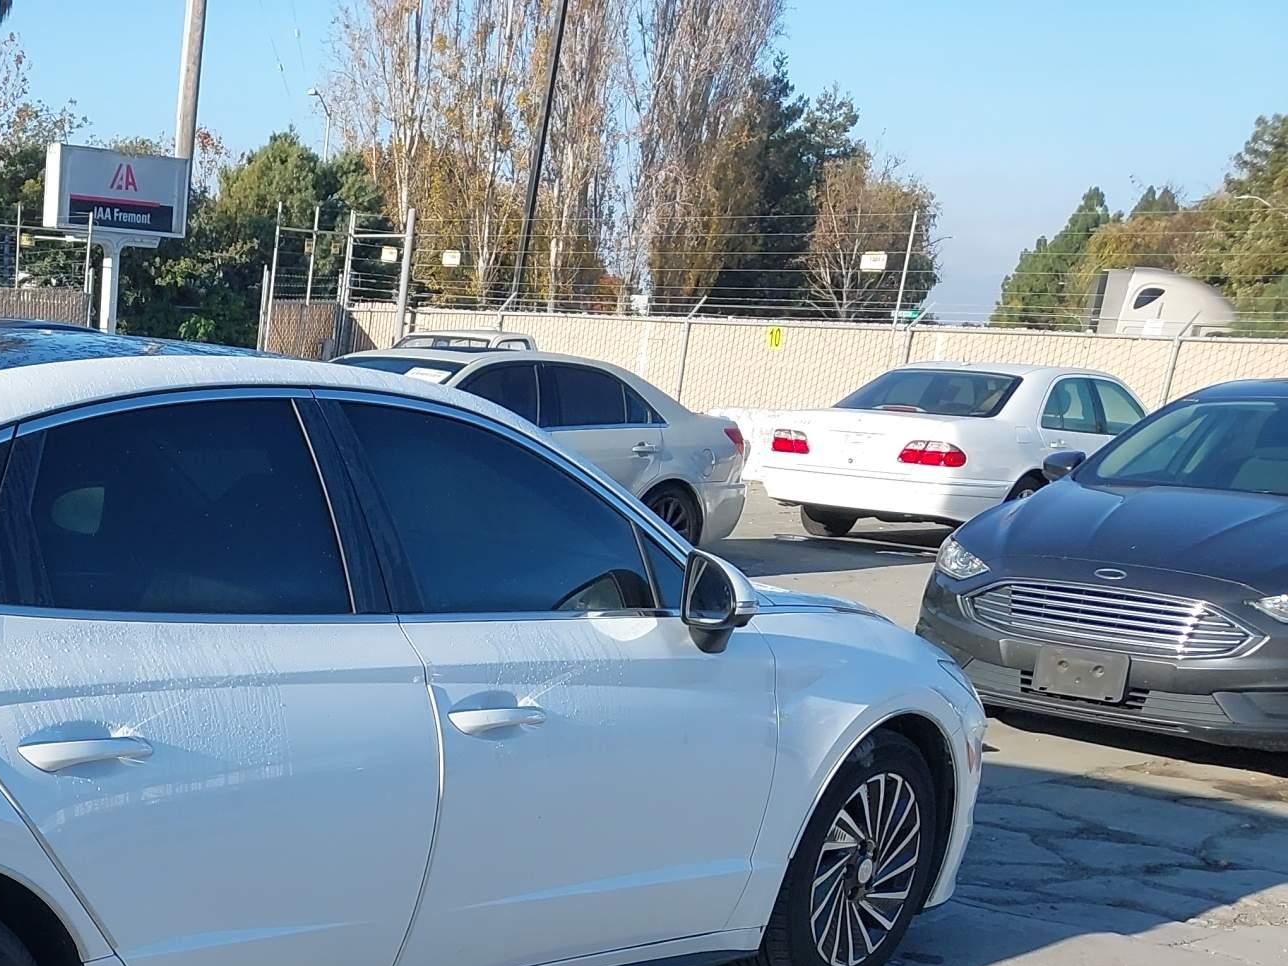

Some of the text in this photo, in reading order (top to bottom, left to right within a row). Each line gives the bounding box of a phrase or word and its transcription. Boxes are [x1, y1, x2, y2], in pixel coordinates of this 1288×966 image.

[93, 206, 152, 225] IAA Fremont
[769, 327, 781, 347] 10
